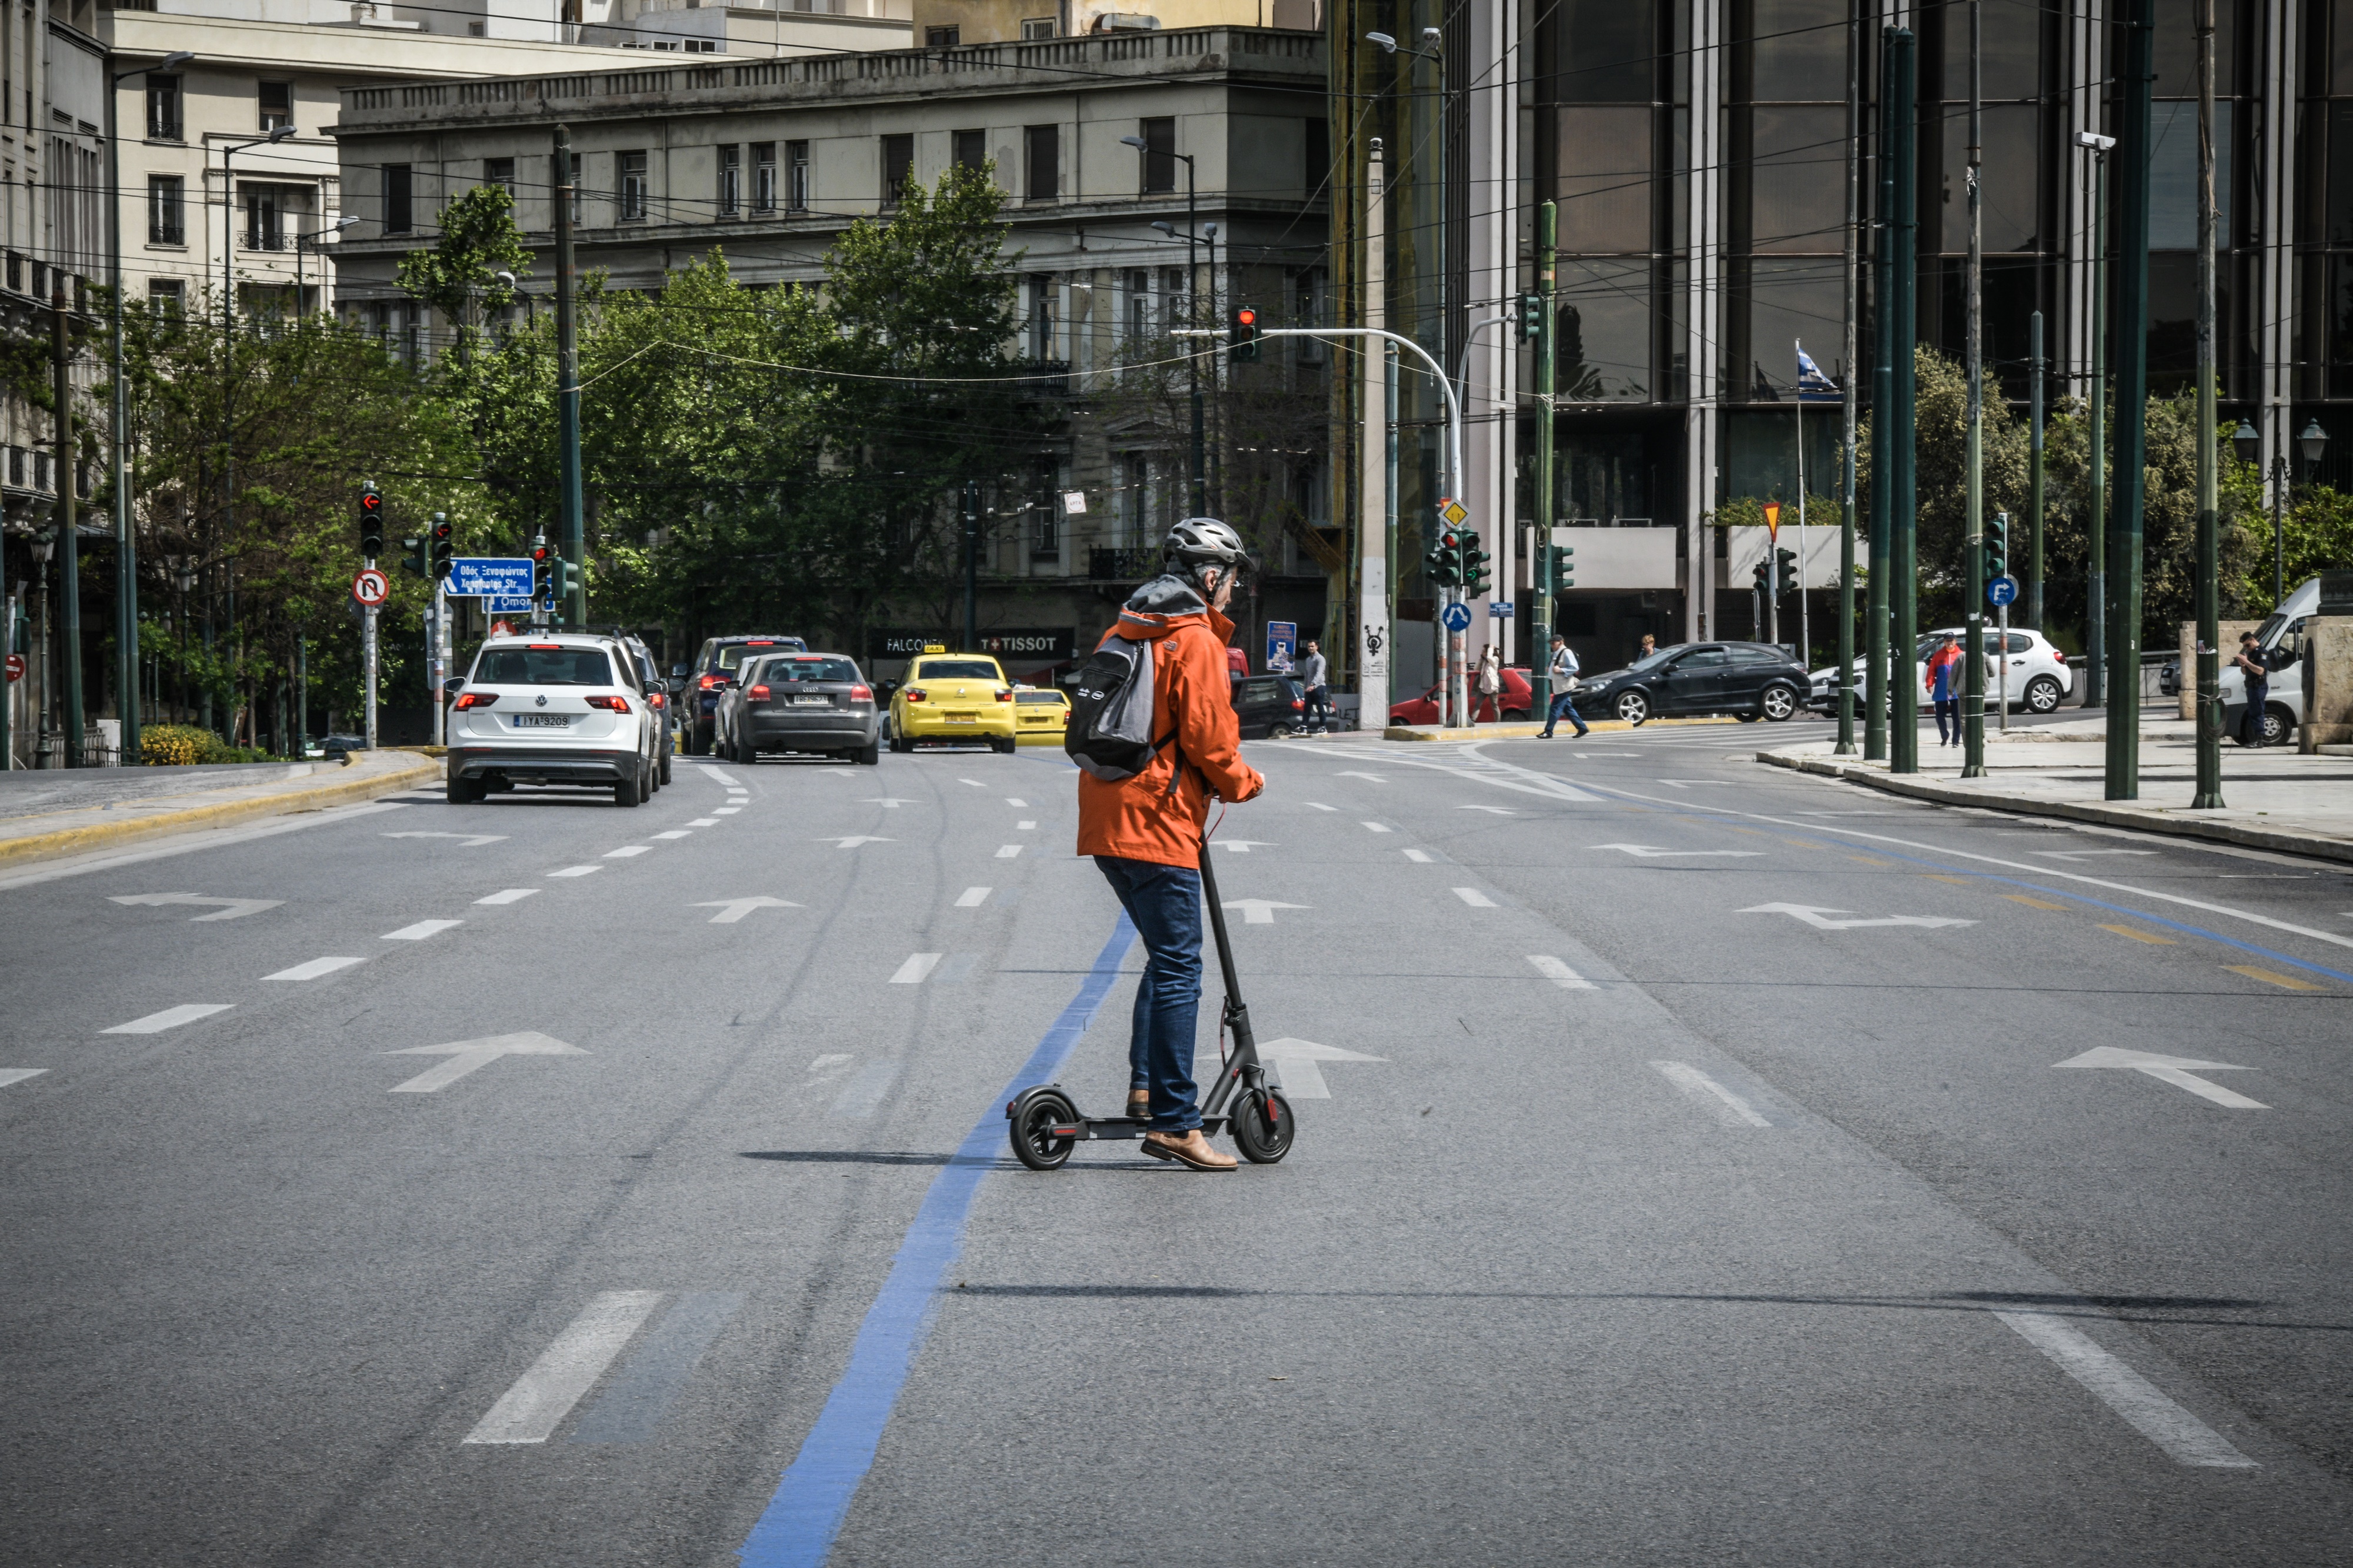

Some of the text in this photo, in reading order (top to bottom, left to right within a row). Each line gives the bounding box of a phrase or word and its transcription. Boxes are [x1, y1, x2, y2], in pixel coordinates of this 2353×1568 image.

[461, 565, 528, 578] Οδός Ξενοφώντος
[1001, 637, 1056, 651] TISSOT
